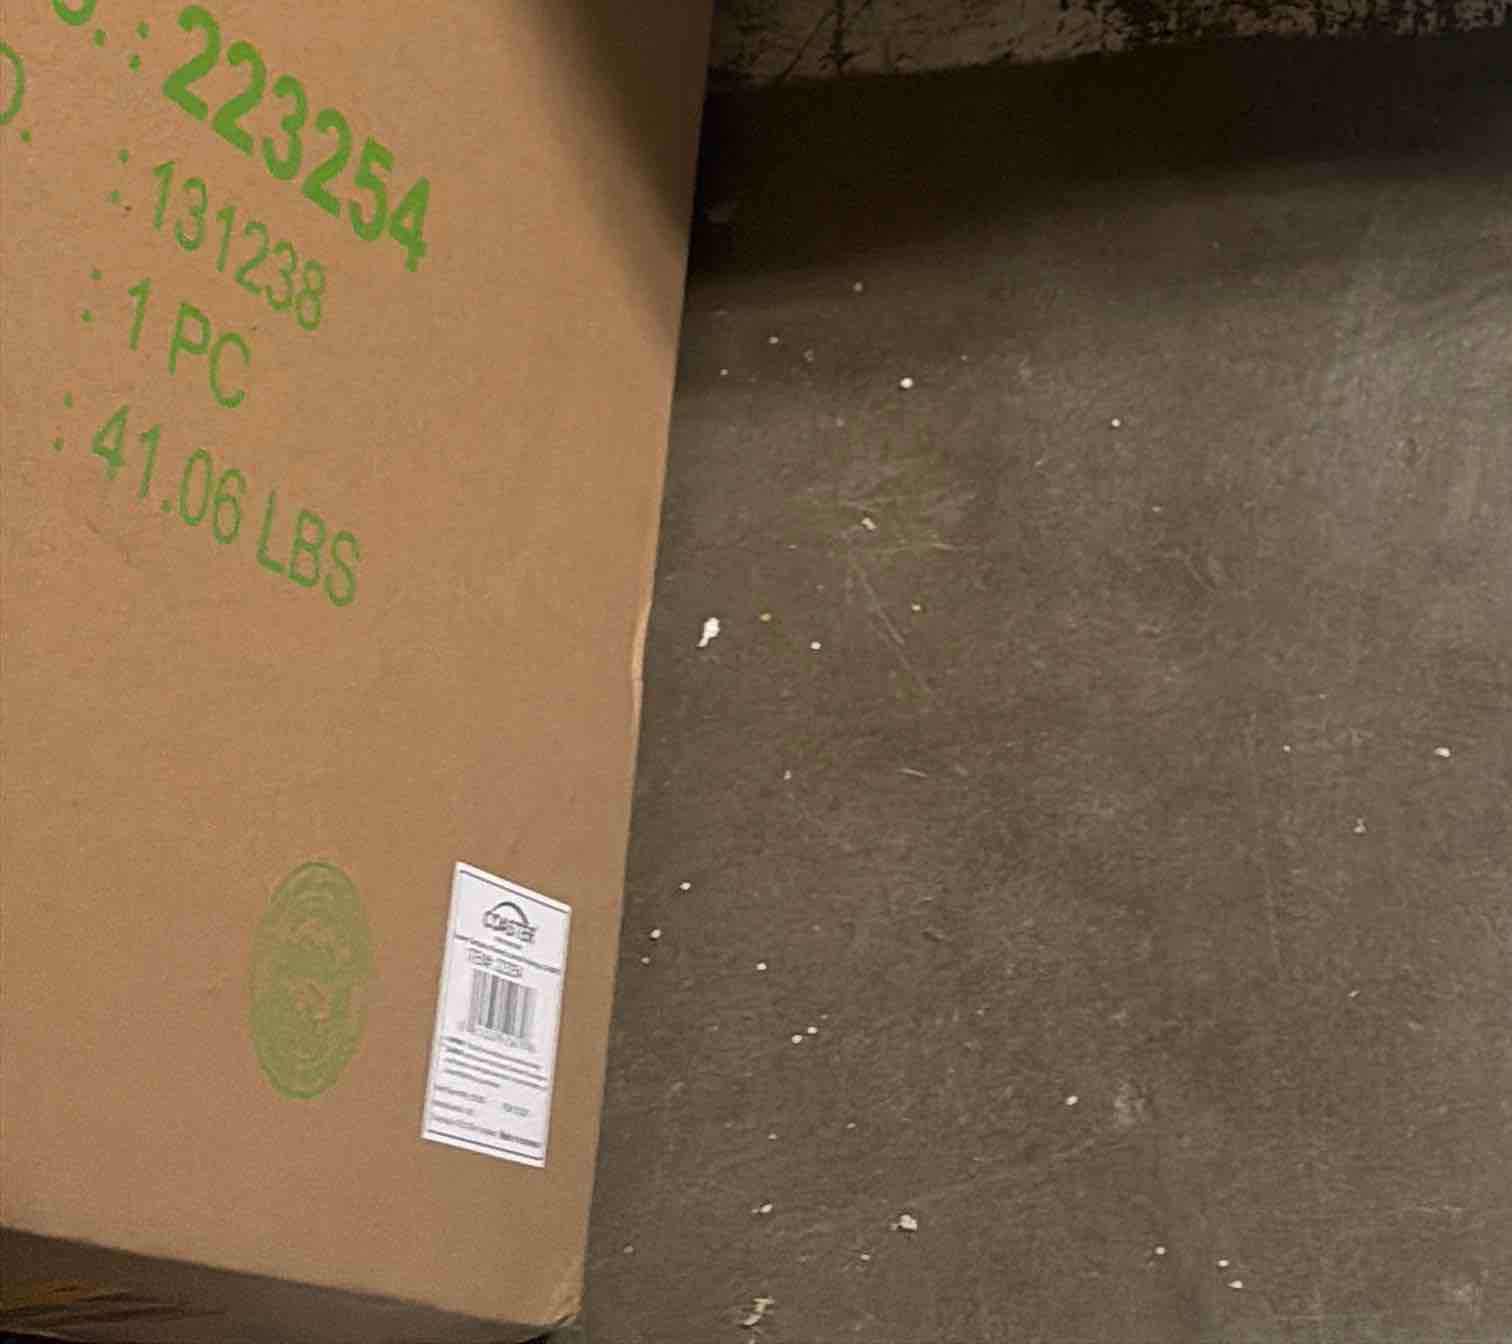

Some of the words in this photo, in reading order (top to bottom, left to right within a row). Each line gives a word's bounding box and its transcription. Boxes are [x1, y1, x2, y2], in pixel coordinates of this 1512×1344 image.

[162, 4, 431, 273] 223254
[152, 159, 326, 331] 131238
[128, 277, 152, 352] 1
[168, 300, 252, 409] PC
[92, 404, 248, 546] 41.06
[257, 489, 362, 607] LBS
